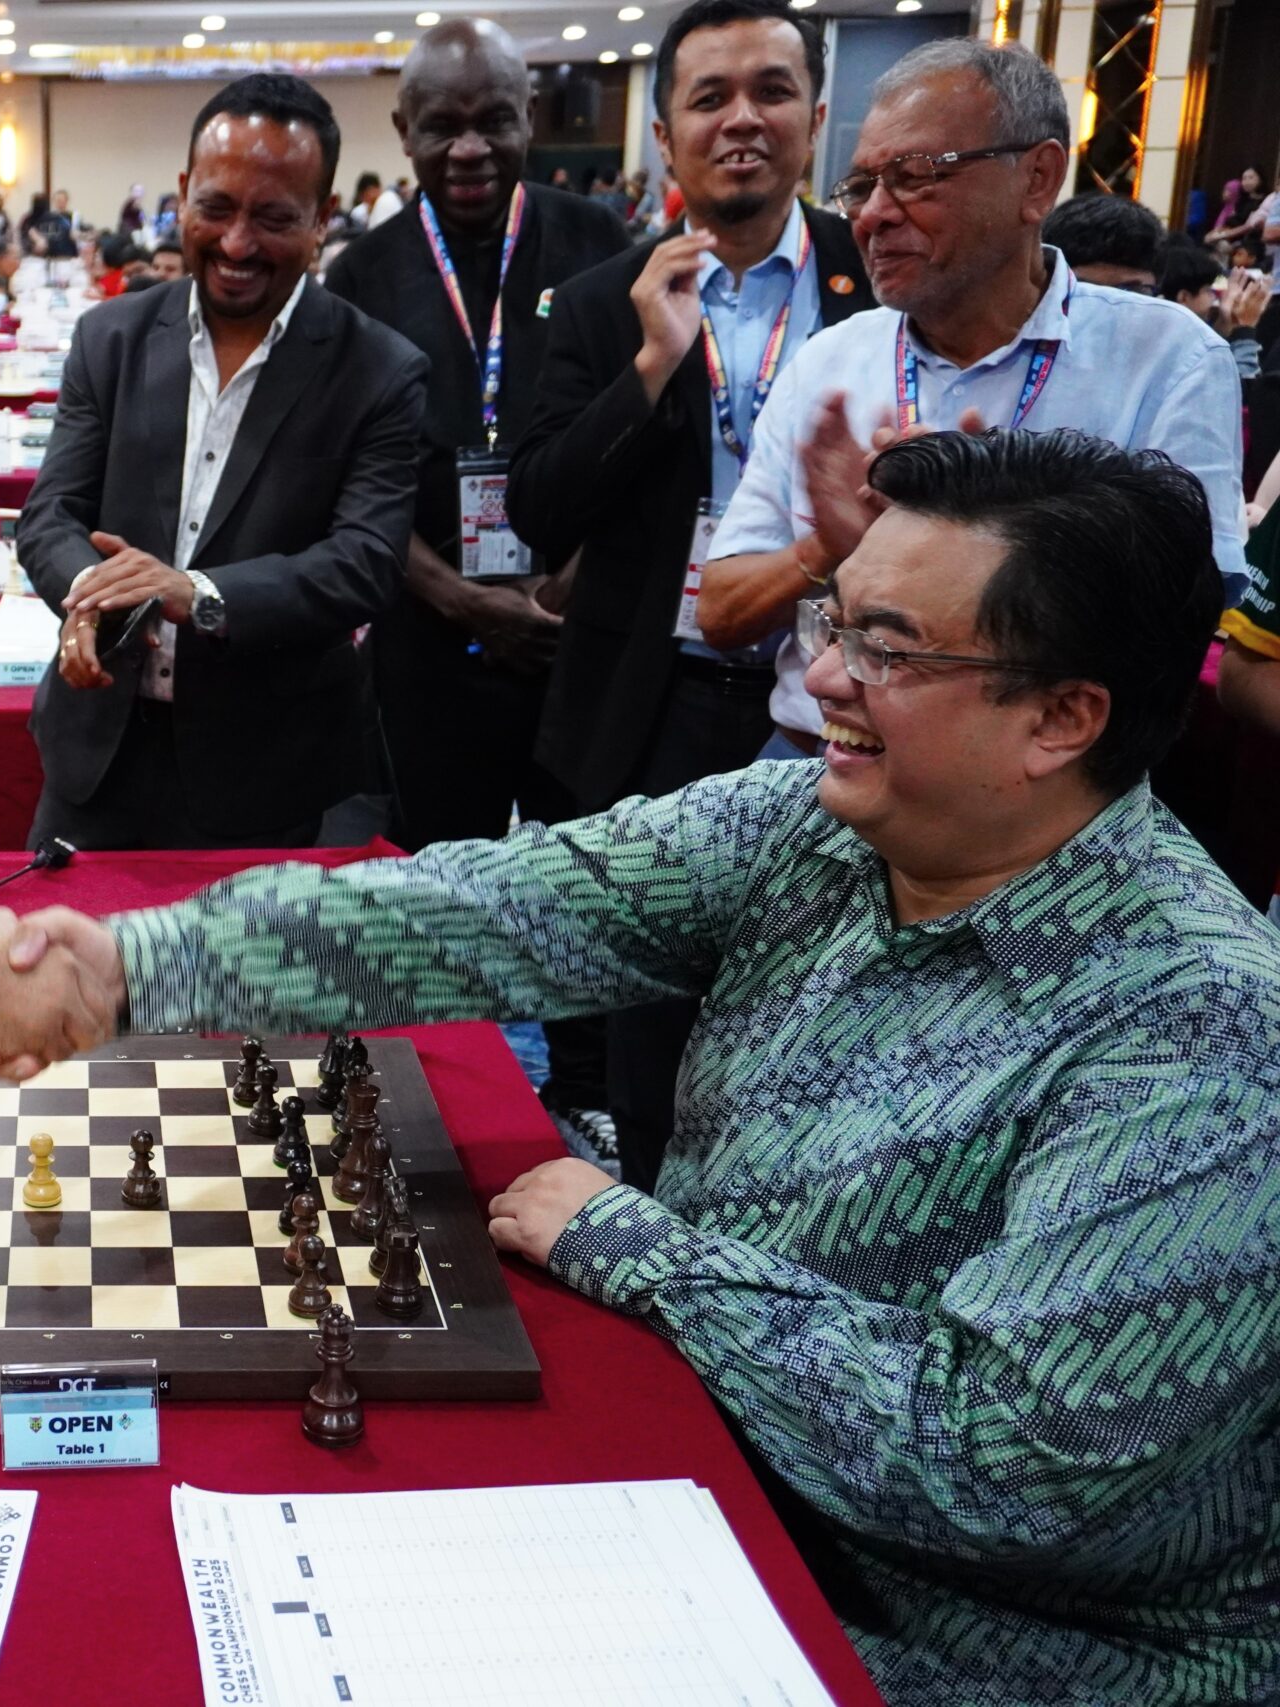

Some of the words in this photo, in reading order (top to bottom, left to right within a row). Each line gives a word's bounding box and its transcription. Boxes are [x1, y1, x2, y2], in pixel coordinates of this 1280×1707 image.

[15, 1378, 32, 1386] Chess
[33, 1378, 50, 1386] Board
[58, 1378, 96, 1392] DGT
[48, 1415, 113, 1434] OPEN
[56, 1444, 94, 1455] Table
[99, 1443, 105, 1453] 1
[210, 1559, 224, 1584] 2025
[192, 1558, 238, 1704] COMMONWEALTH
[216, 1589, 244, 1664] CHAMPIONSHIP
[236, 1669, 253, 1703] CHESS
